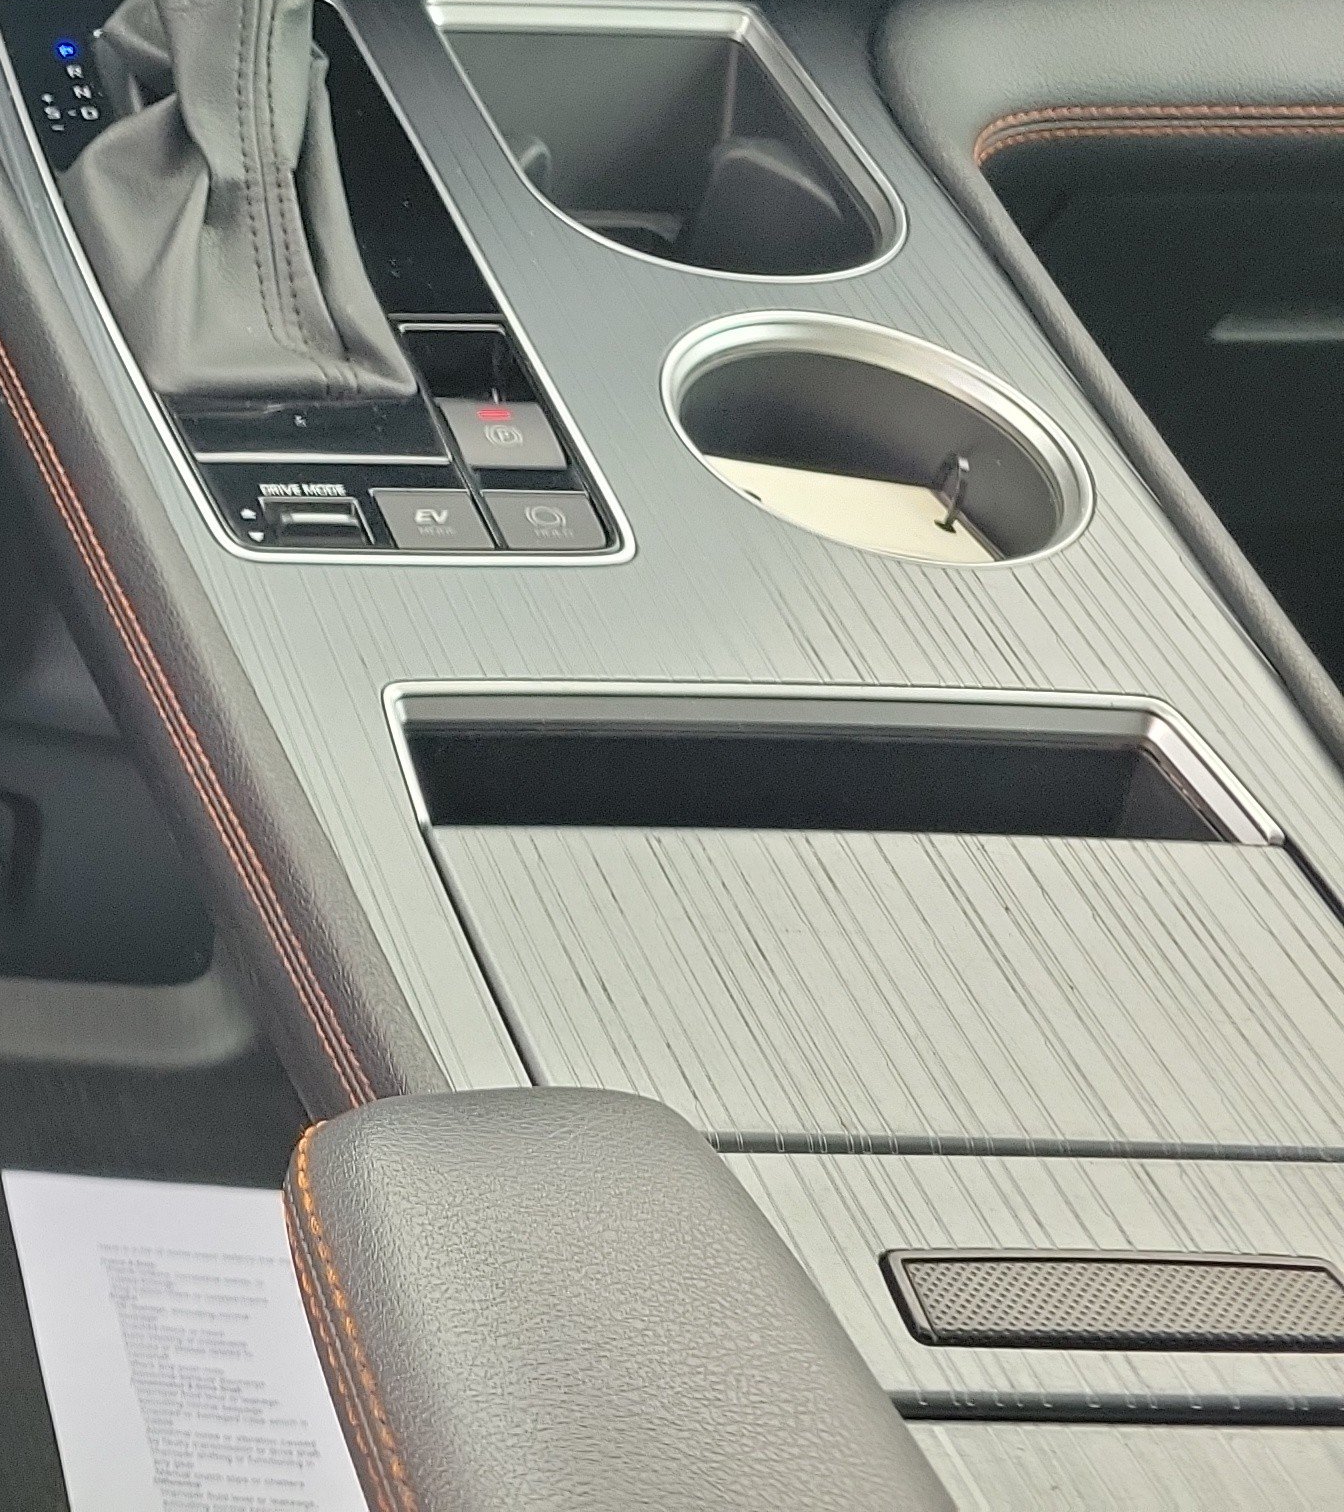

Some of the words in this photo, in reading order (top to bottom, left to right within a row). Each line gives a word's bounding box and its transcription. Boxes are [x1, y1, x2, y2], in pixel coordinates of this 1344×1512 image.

[259, 484, 302, 496] DRIVE
[302, 484, 347, 497] MODE
[415, 509, 448, 525] EV
